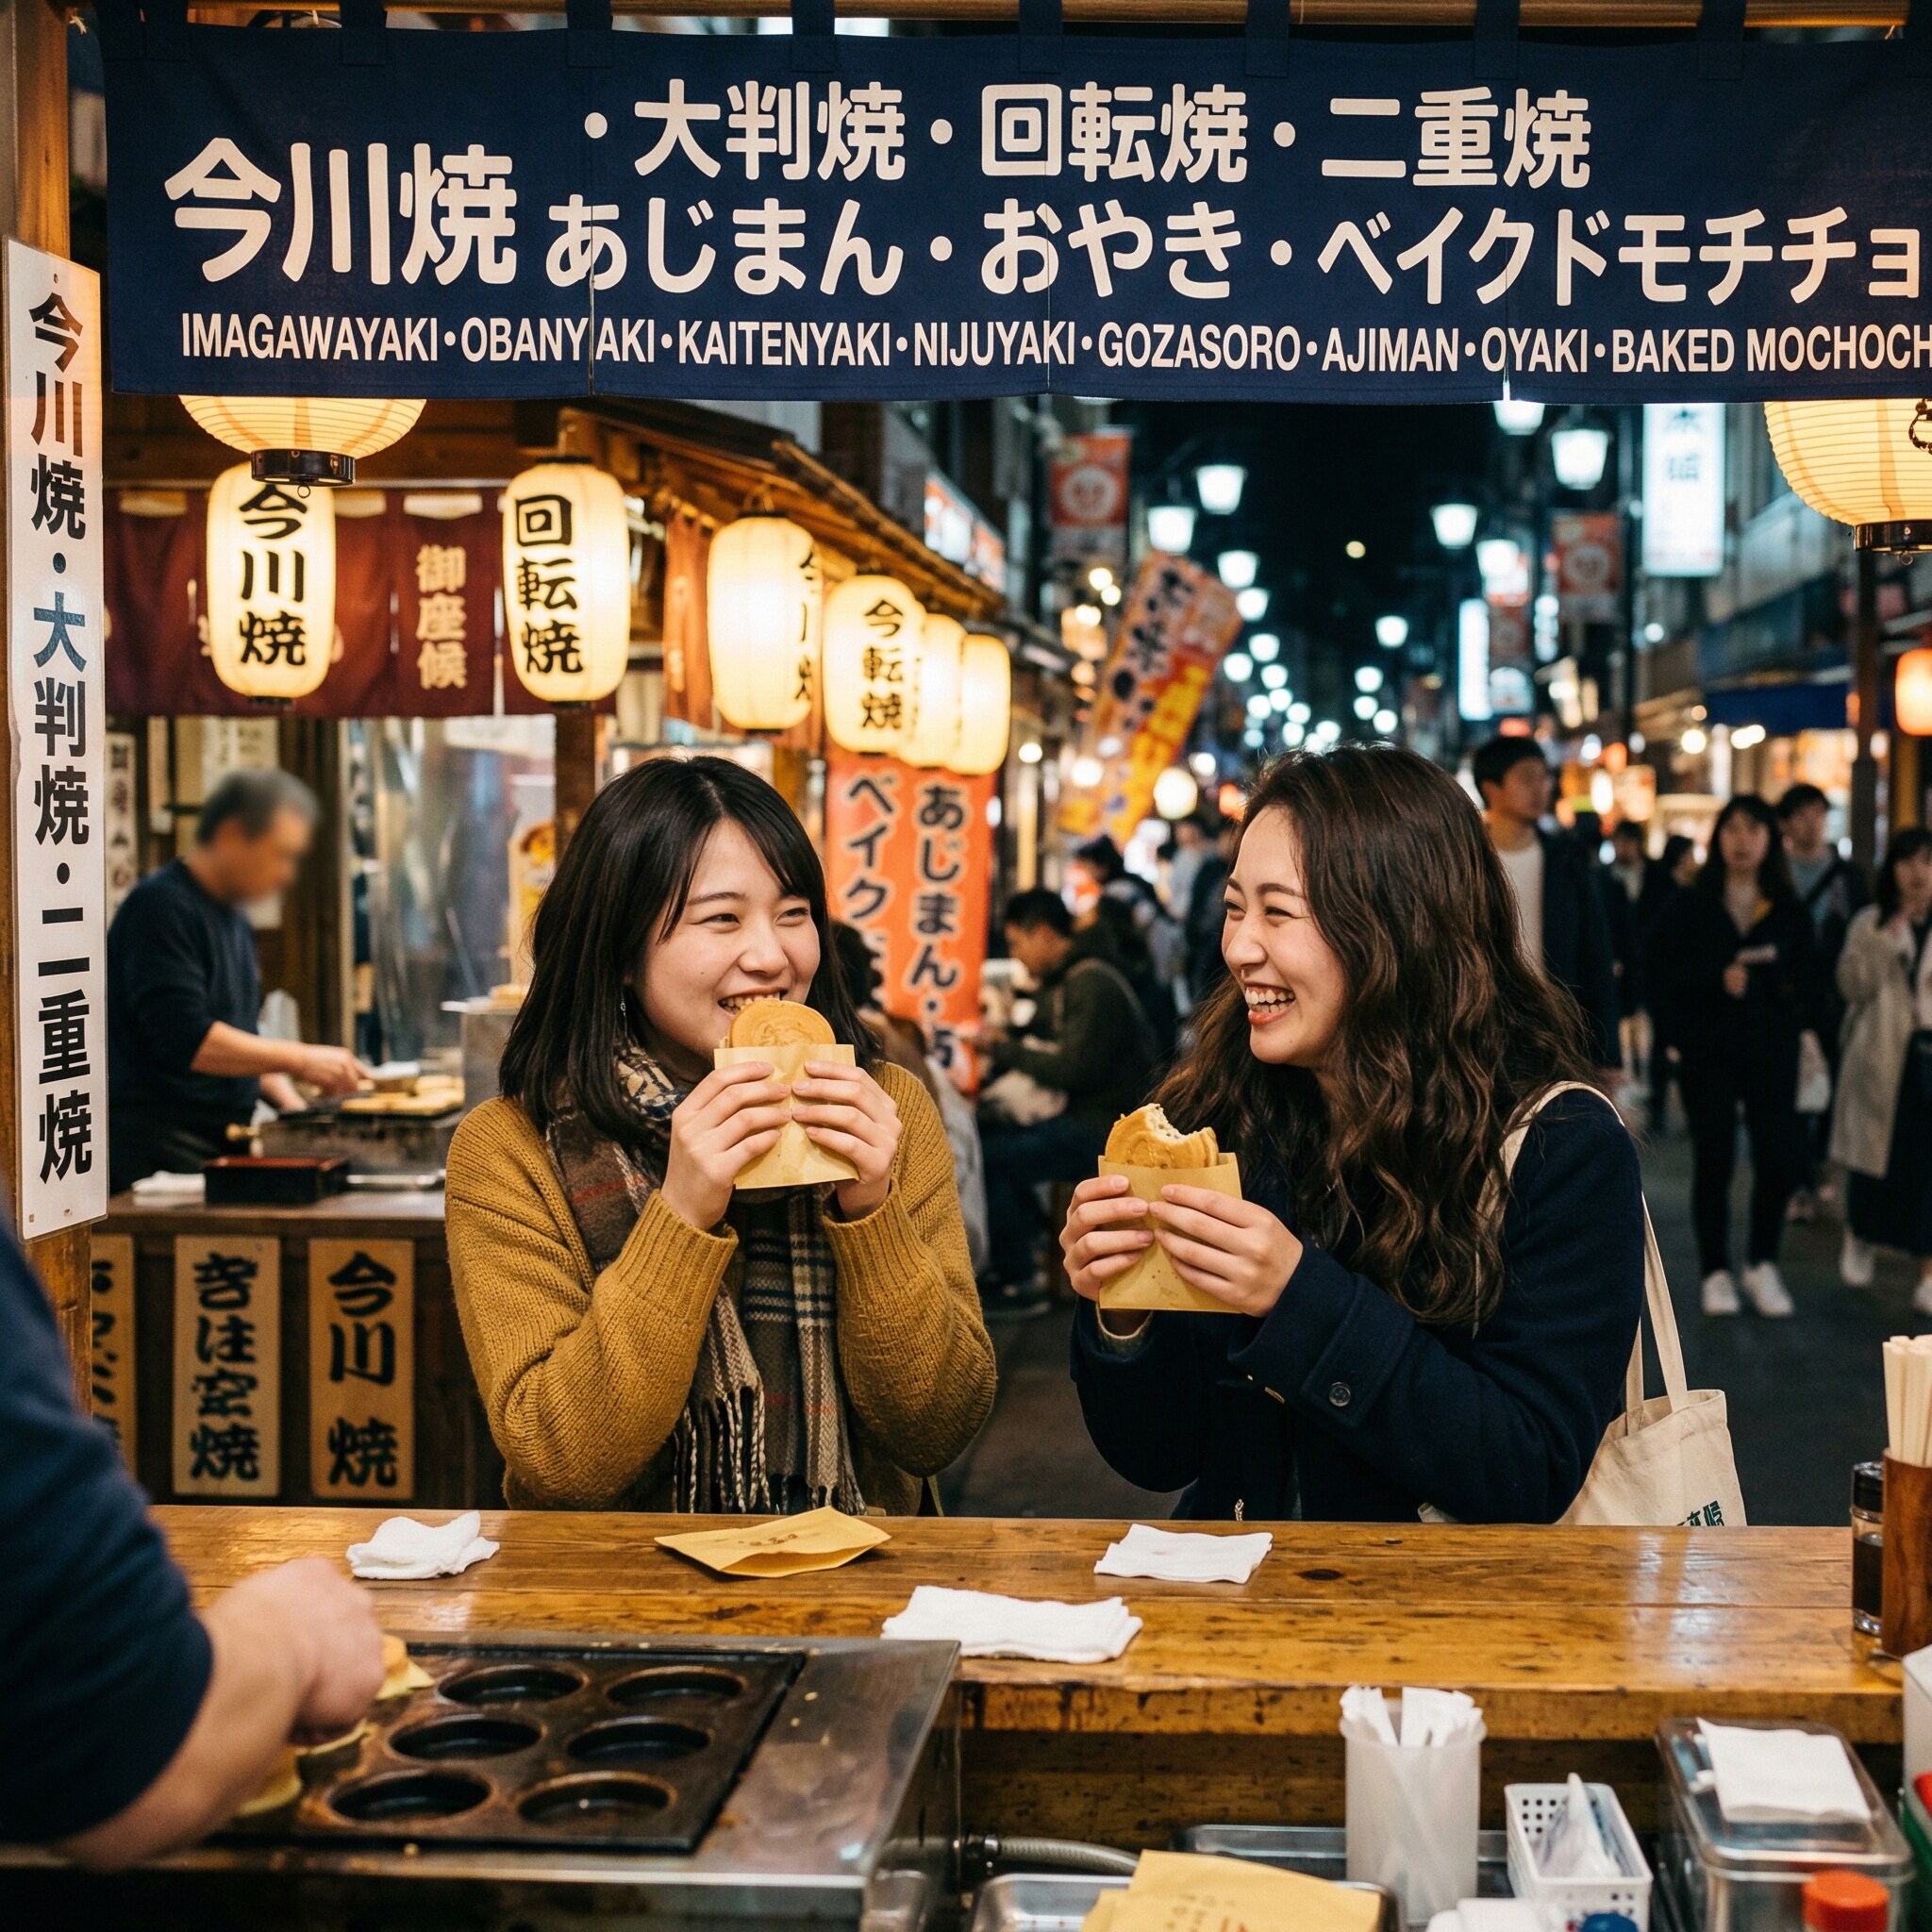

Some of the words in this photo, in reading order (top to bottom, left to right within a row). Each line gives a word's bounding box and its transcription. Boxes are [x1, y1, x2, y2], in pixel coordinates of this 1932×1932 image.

[165, 138, 516, 285] 今川焼
[1748, 325, 1932, 371] MOCHOCH
[240, 484, 308, 666] 今川焼
[515, 495, 583, 675] 回転焼
[846, 773, 894, 943] ベイク
[327, 1251, 398, 1487] 今川焼
